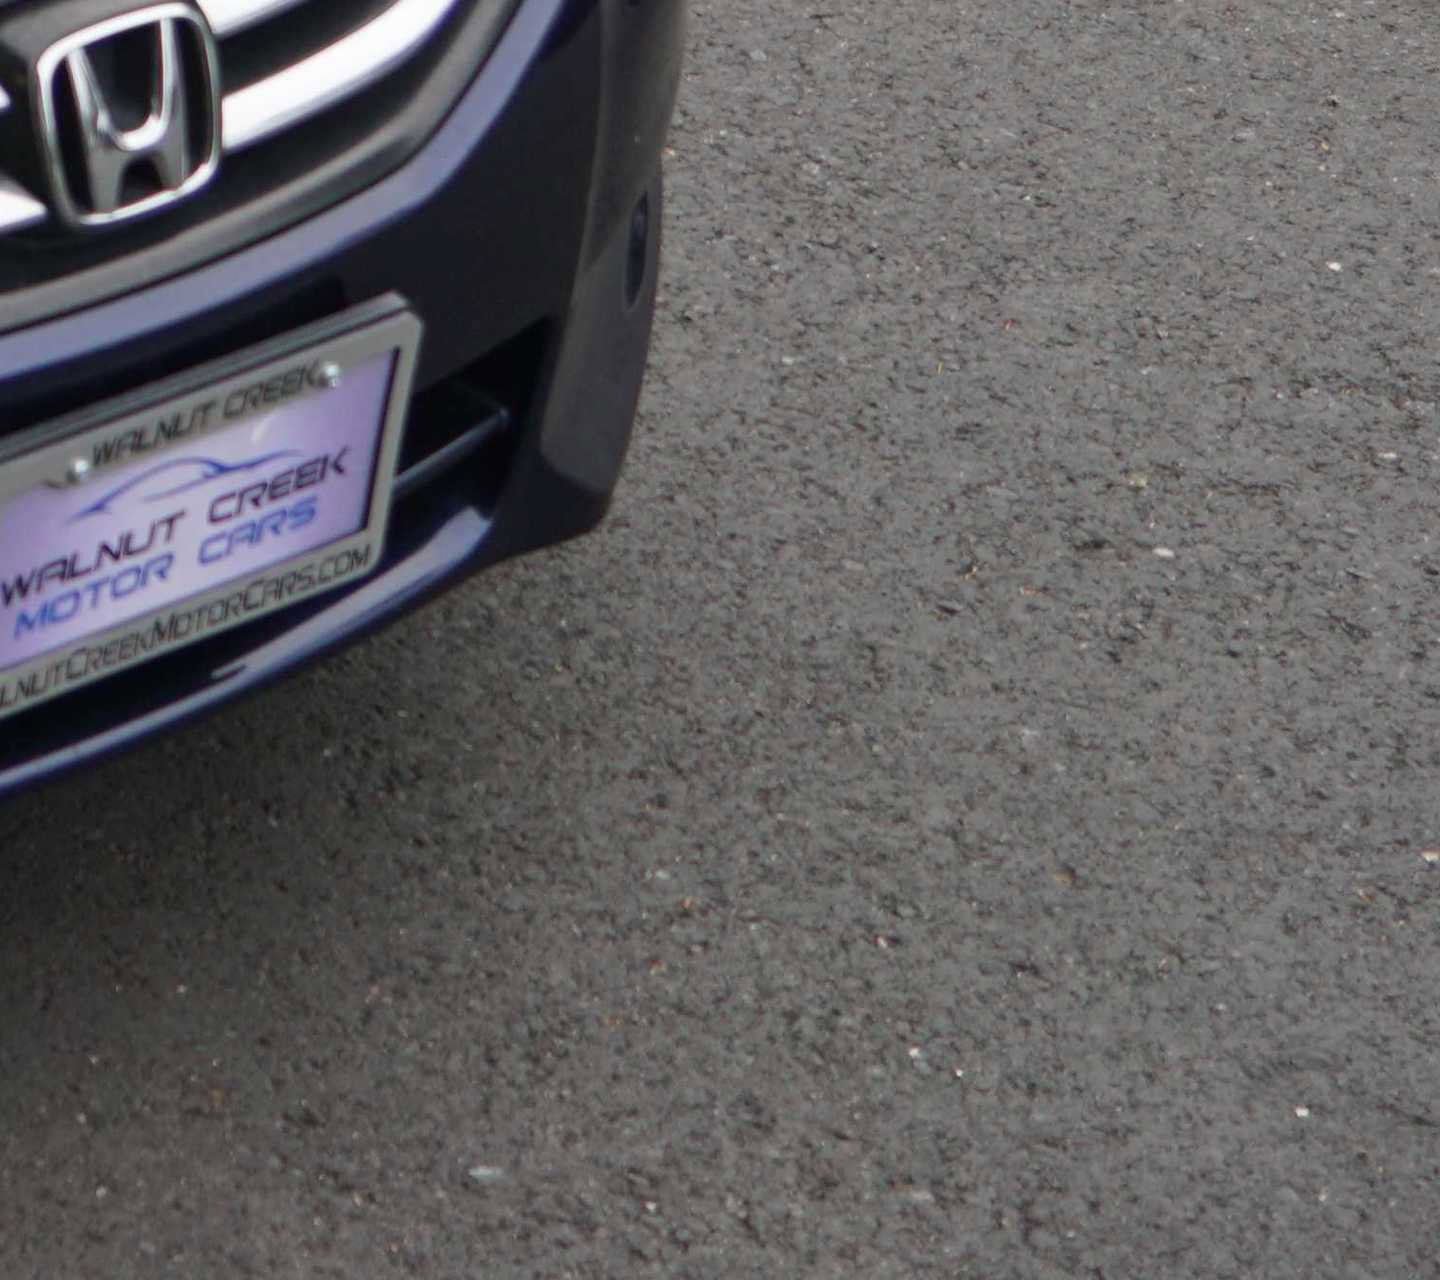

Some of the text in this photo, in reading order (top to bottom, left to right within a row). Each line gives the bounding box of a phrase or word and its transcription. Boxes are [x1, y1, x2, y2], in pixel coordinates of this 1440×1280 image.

[92, 359, 322, 467] WALNUT CREEK
[0, 447, 352, 607] WALNUT CREEK
[13, 495, 320, 641] MOTOR CARS
